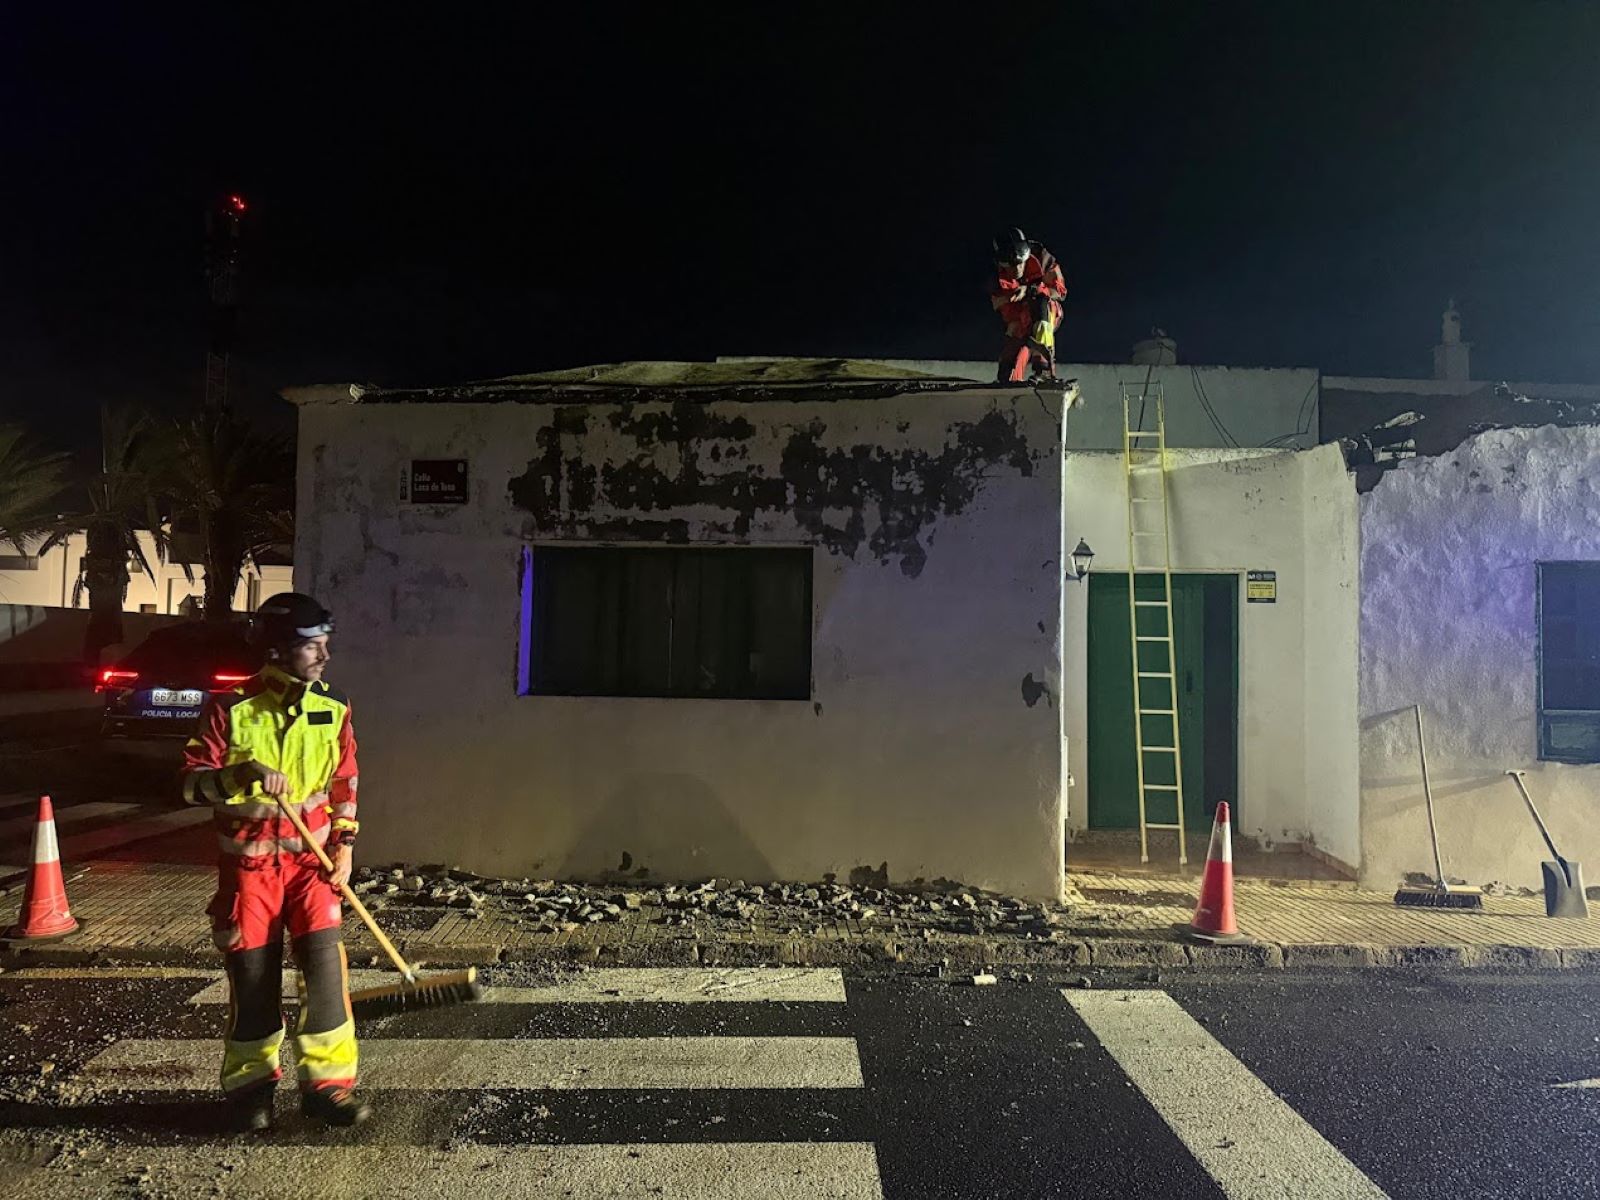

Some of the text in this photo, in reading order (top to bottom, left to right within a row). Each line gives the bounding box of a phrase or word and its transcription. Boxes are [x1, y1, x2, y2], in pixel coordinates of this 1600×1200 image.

[414, 472, 431, 481] Calle
[154, 691, 199, 702] 6673 MSS
